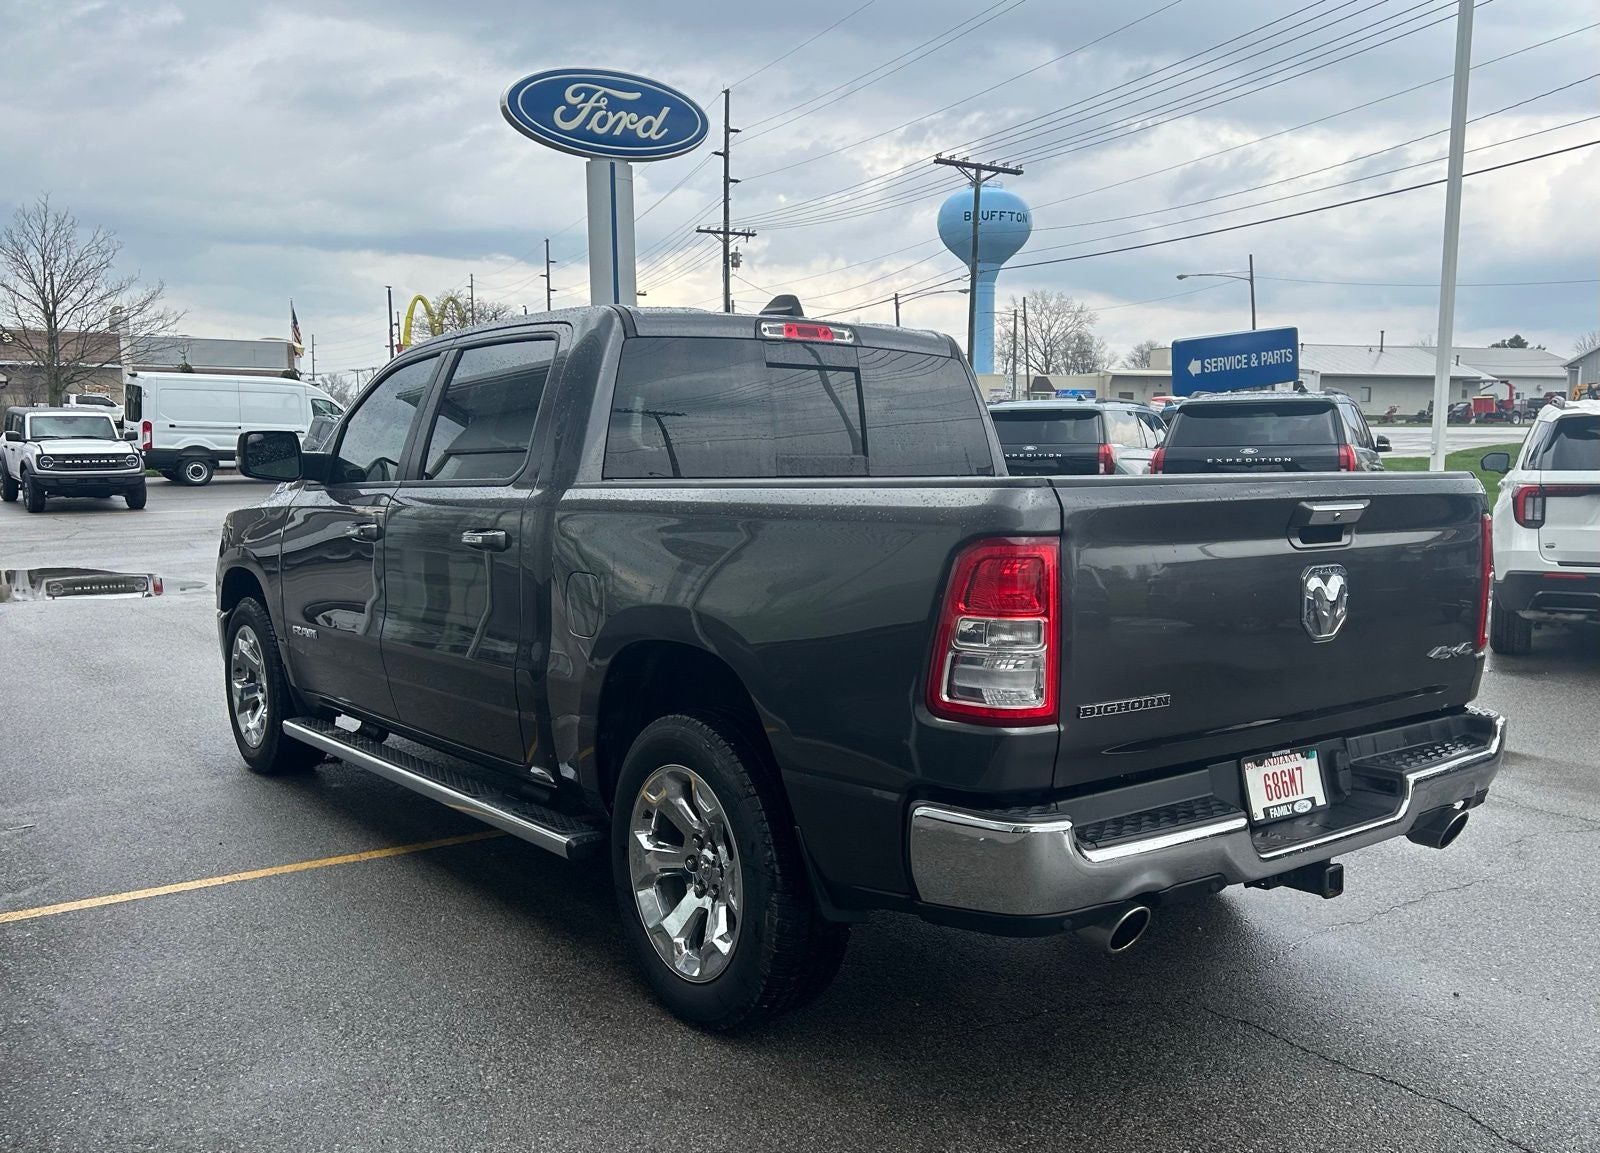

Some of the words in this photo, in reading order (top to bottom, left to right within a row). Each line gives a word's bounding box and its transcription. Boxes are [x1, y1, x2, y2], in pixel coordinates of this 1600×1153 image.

[553, 83, 671, 141] Ford
[963, 210, 1028, 223] BUFFTON
[1204, 354, 1248, 373] SERVICE
[1250, 353, 1259, 367] &
[1261, 348, 1293, 366] PARTS
[1079, 694, 1171, 719] BIGHORN
[1263, 766, 1304, 802] 686M7
[1269, 803, 1293, 819] FAMILY
